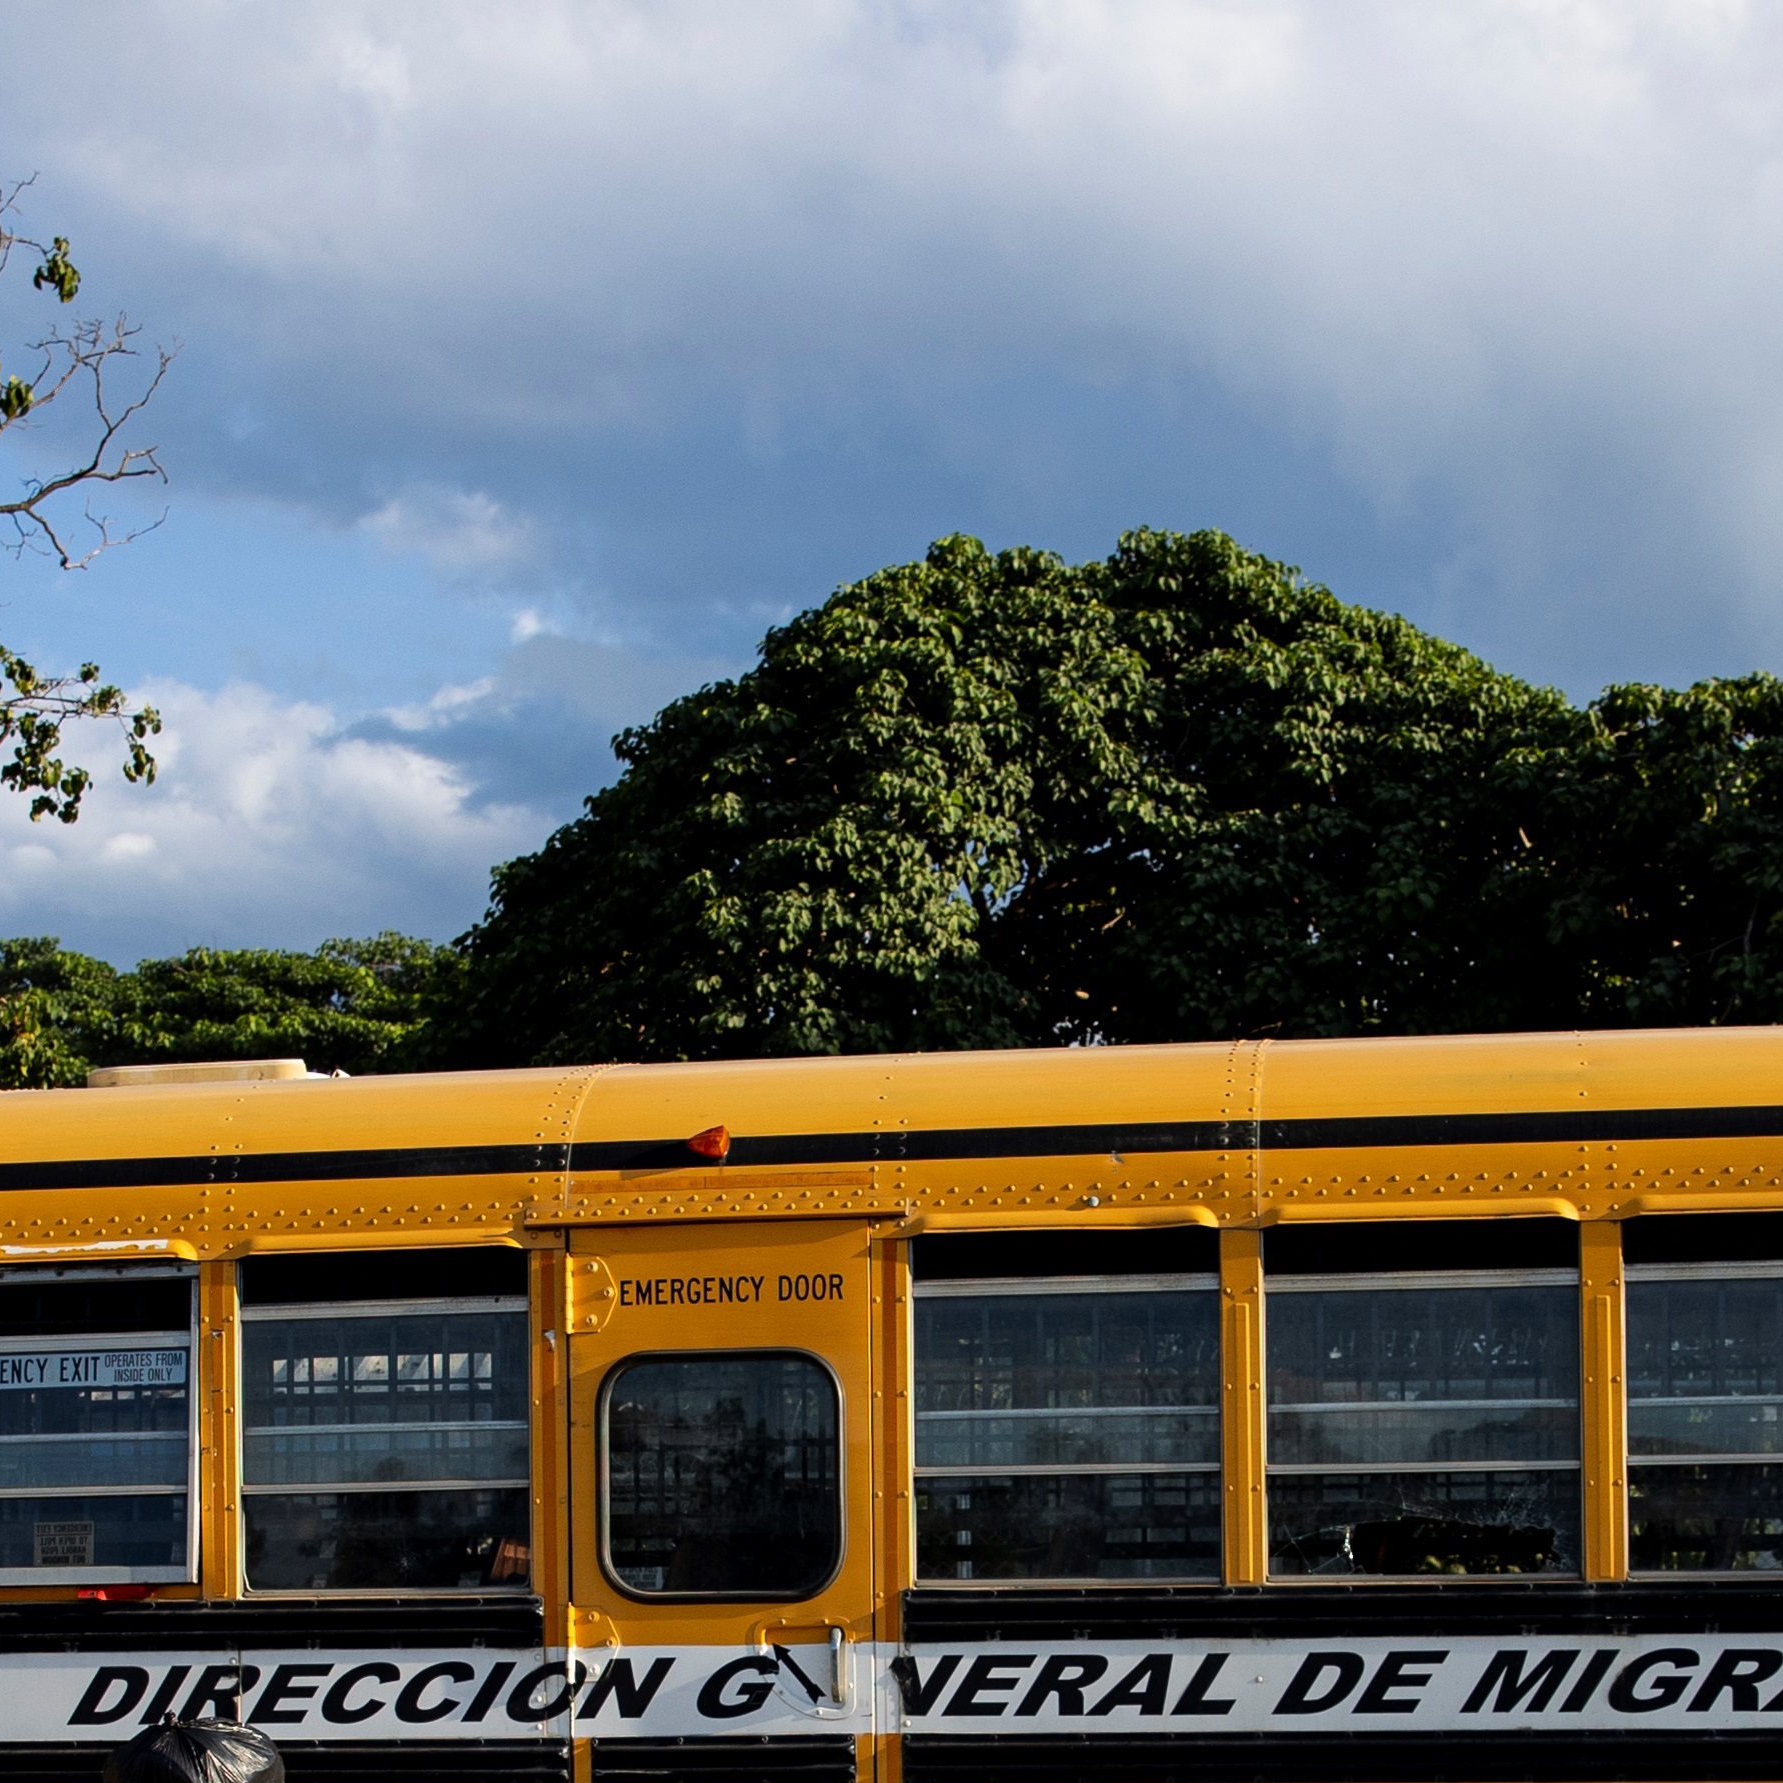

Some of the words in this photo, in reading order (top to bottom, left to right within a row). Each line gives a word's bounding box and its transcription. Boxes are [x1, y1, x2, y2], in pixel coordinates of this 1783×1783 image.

[619, 1276, 765, 1306] EMERGENCY
[778, 1273, 844, 1302] DOOR
[59, 1356, 101, 1383] EXIT
[104, 1354, 152, 1369] OPERATES
[155, 1352, 183, 1367] FROM
[113, 1369, 145, 1383] INSIDE
[147, 1367, 174, 1382] ONLY
[67, 1656, 674, 1728] DIRECCION
[696, 1652, 1235, 1719] GNERAL
[1272, 1650, 1449, 1717] DE
